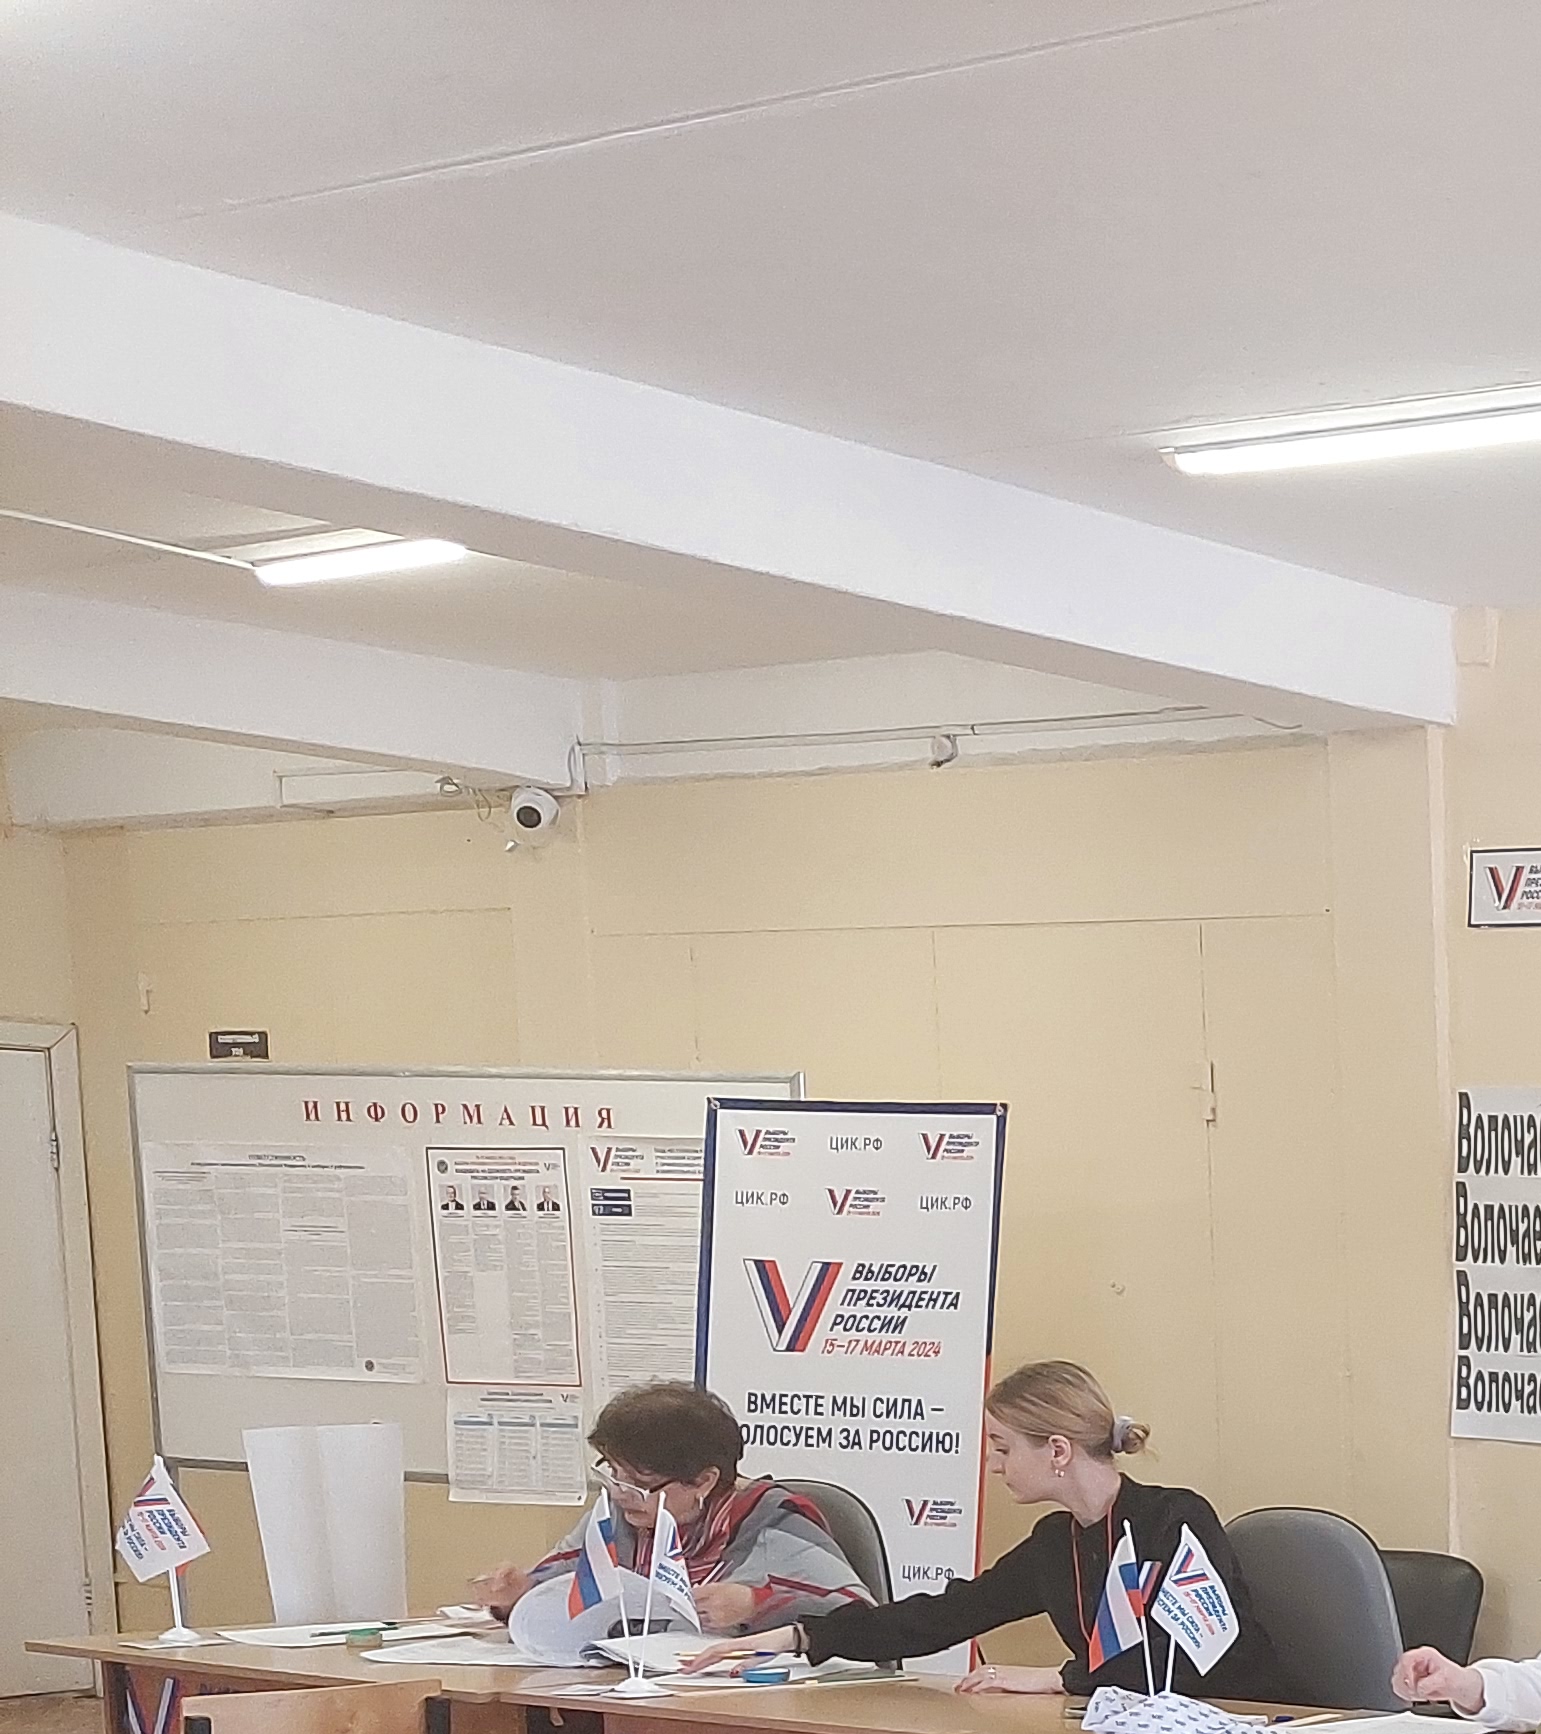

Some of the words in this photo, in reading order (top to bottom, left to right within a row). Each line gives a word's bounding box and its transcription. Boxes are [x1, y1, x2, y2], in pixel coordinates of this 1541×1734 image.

[302, 1100, 615, 1131] ИНФОРМАЦИЯ
[828, 1135, 884, 1153] ЦИК.РФ
[734, 1189, 791, 1208] ЦИК.РФ
[918, 1194, 973, 1213] ЦИК.РФ
[850, 1262, 938, 1285] ВЫБОРЫ
[839, 1288, 962, 1313] ПРЕЗИДЕНТА
[828, 1313, 909, 1336] РОССИИ
[820, 1337, 862, 1357] 15–17
[860, 1339, 907, 1358] МАРТА
[907, 1340, 942, 1359] 2024
[746, 1391, 826, 1417] ВМЕСТЕ
[830, 1394, 867, 1419] МЫ
[872, 1396, 926, 1421] СИЛА
[740, 1423, 833, 1450] ОЛОСУЕМ
[838, 1427, 864, 1451] ЗА
[868, 1429, 961, 1455] РОССИЮ!
[901, 1564, 956, 1582] ЦИК.РФ
